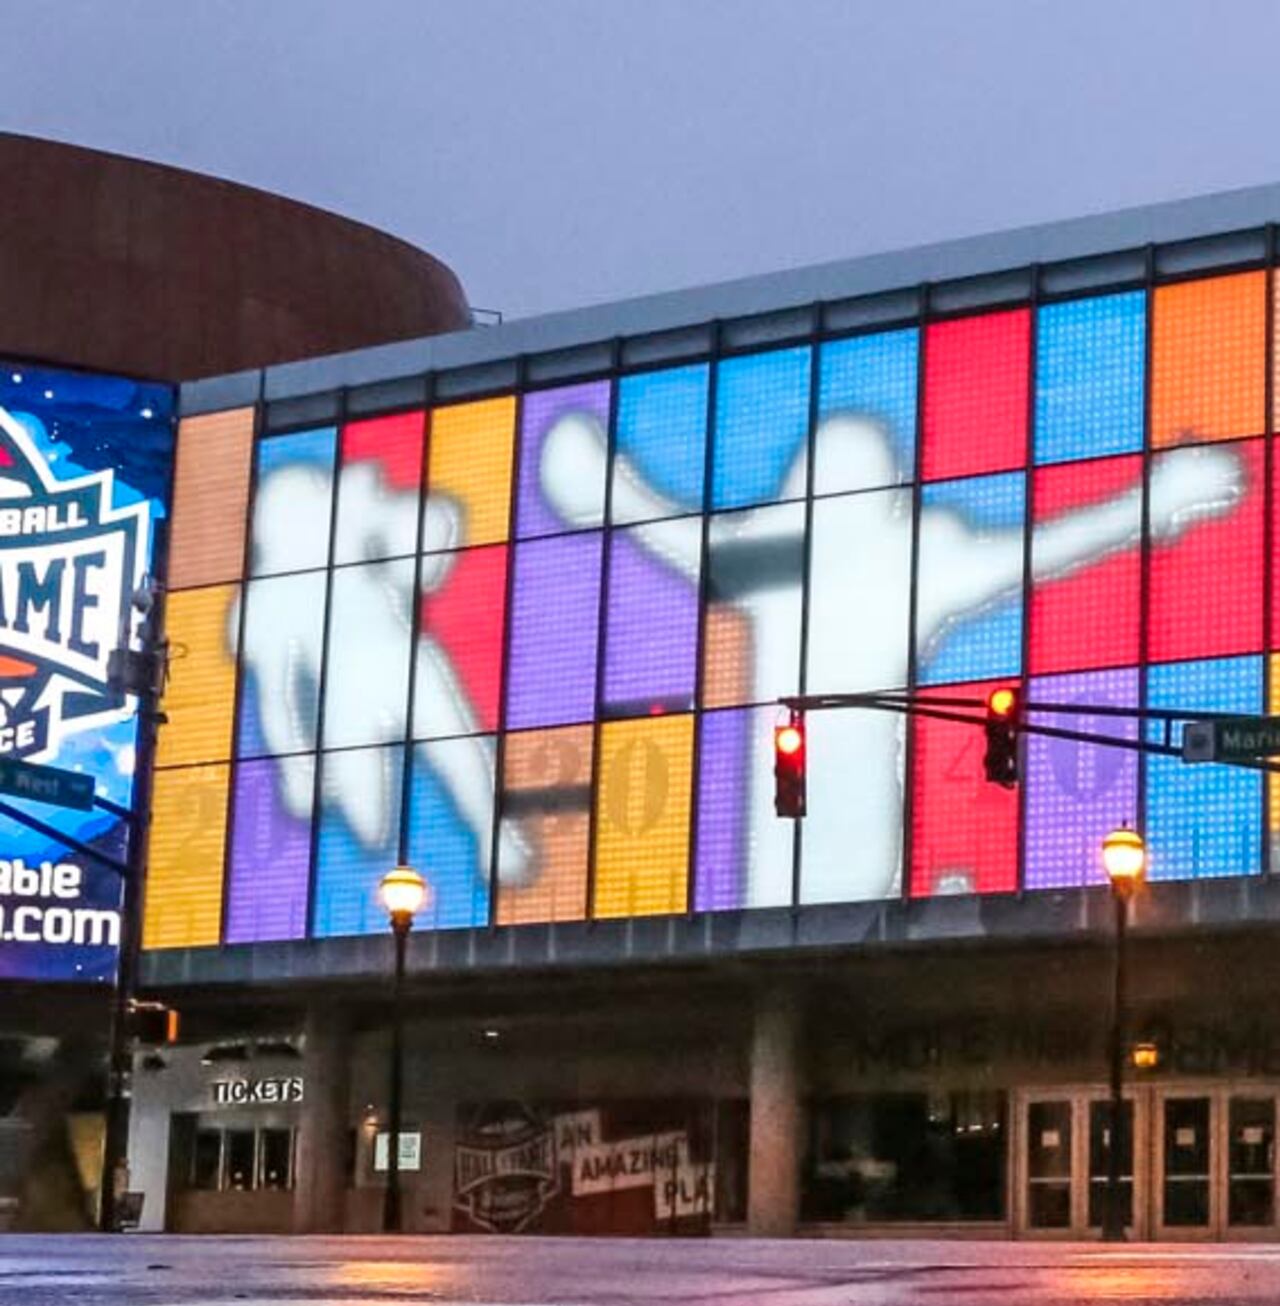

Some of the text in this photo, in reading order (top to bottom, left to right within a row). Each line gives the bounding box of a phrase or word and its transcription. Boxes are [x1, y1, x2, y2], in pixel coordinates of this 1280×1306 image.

[0, 550, 105, 660] ME
[0, 906, 121, 945] .com
[215, 1077, 304, 1103] TICKETS
